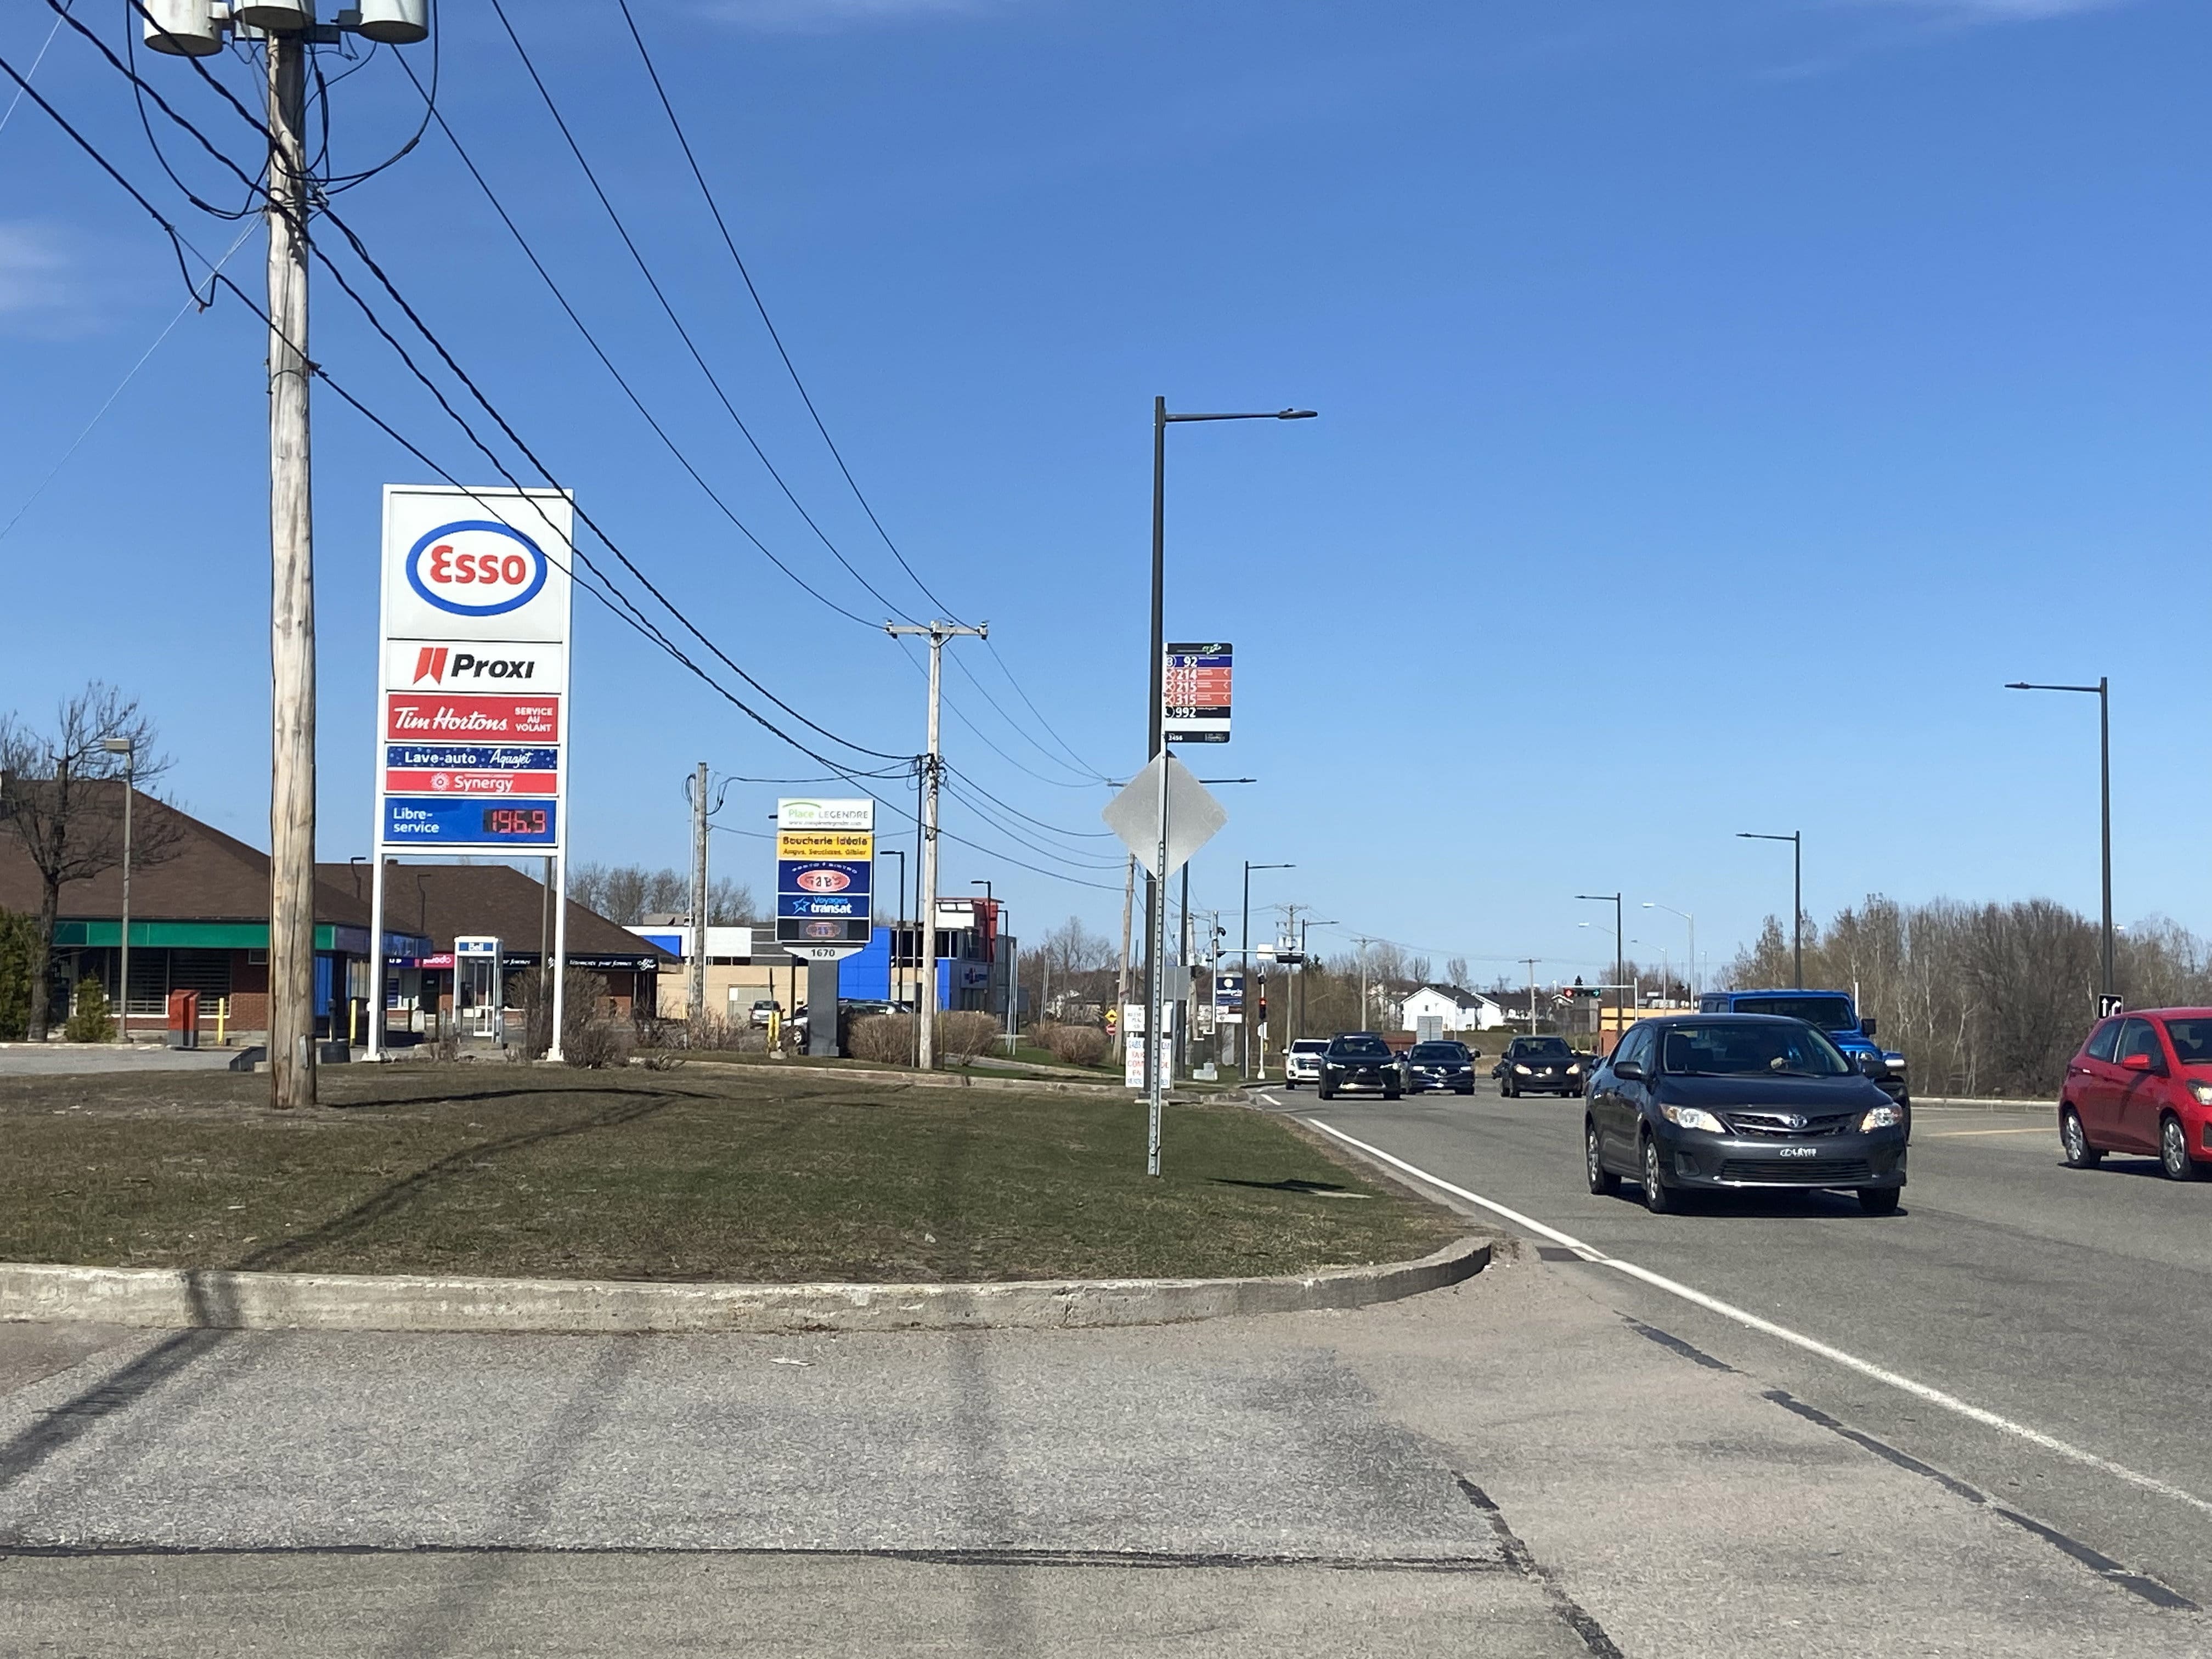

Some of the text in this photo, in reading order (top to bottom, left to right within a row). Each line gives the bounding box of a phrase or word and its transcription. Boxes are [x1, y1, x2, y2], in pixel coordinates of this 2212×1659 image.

[451, 653, 534, 679] Proxi
[1183, 656, 1198, 668] 92
[1176, 669, 1197, 680] 214
[1176, 682, 1197, 692] 215
[1175, 694, 1196, 705] 315
[515, 707, 553, 716] SERVICE
[1175, 707, 1196, 718] 992
[394, 706, 508, 731] Tim Hortons
[515, 724, 552, 732] VOLANT
[404, 749, 534, 769] Lave-auto Aquajet
[454, 775, 514, 793] Synergy
[393, 807, 433, 820] Libre-
[788, 809, 868, 819] Place LEGENDRE
[393, 822, 439, 833] service
[783, 837, 833, 845] Boucherie
[814, 896, 849, 905] Voyages
[811, 904, 853, 914] transat
[811, 949, 836, 957] 1670
